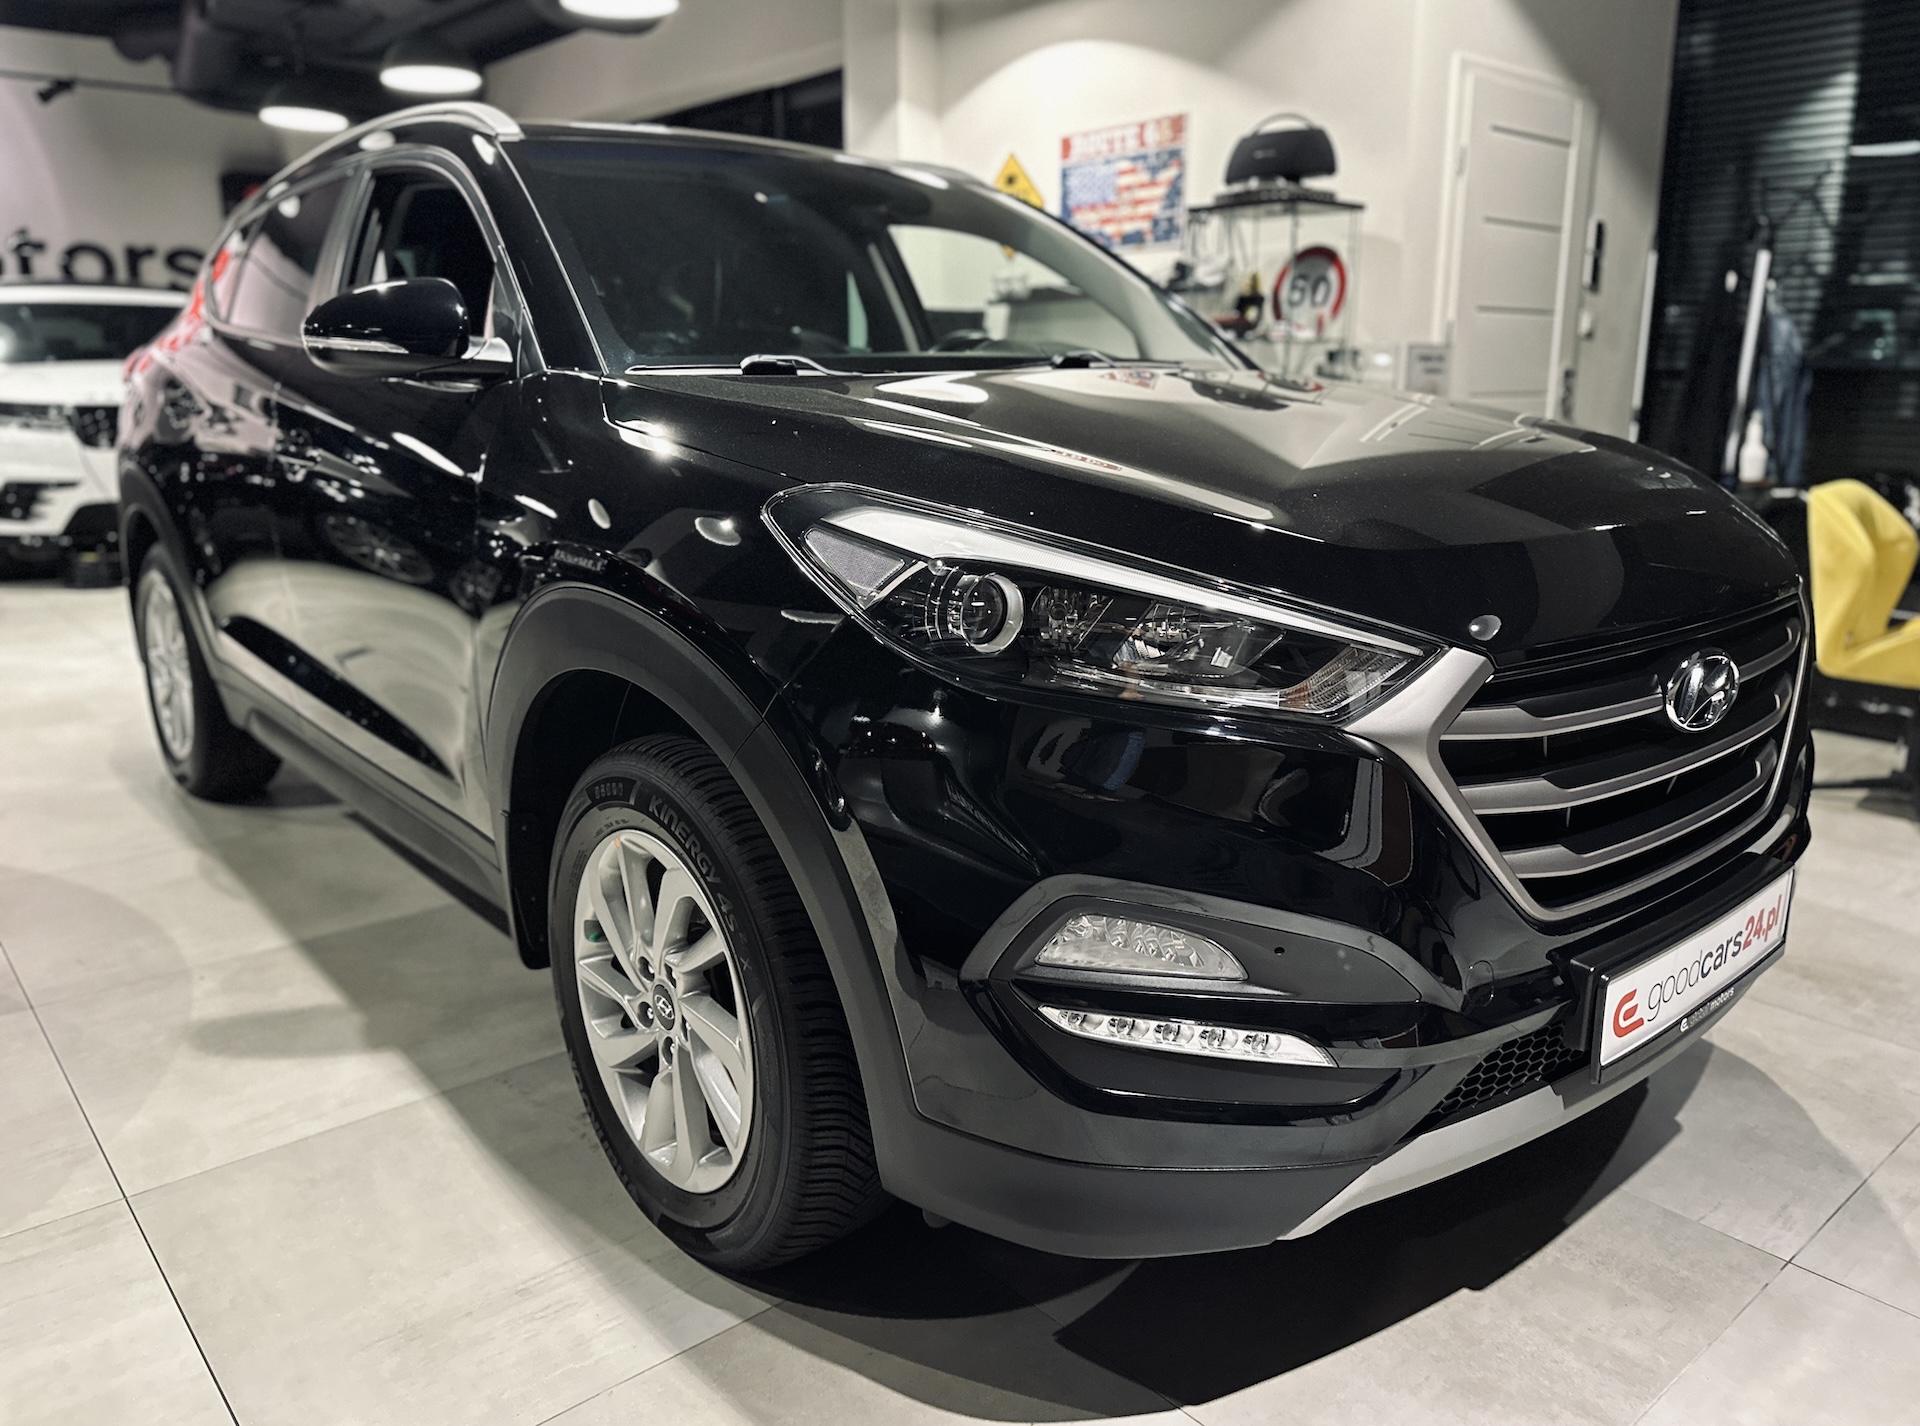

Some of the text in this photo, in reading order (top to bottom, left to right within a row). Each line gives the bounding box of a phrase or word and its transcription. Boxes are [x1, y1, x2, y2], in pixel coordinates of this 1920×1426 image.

[0, 229, 206, 291] tors
[1646, 894, 1783, 1023] goodcars24.pl
[1709, 986, 1735, 1011] motors
